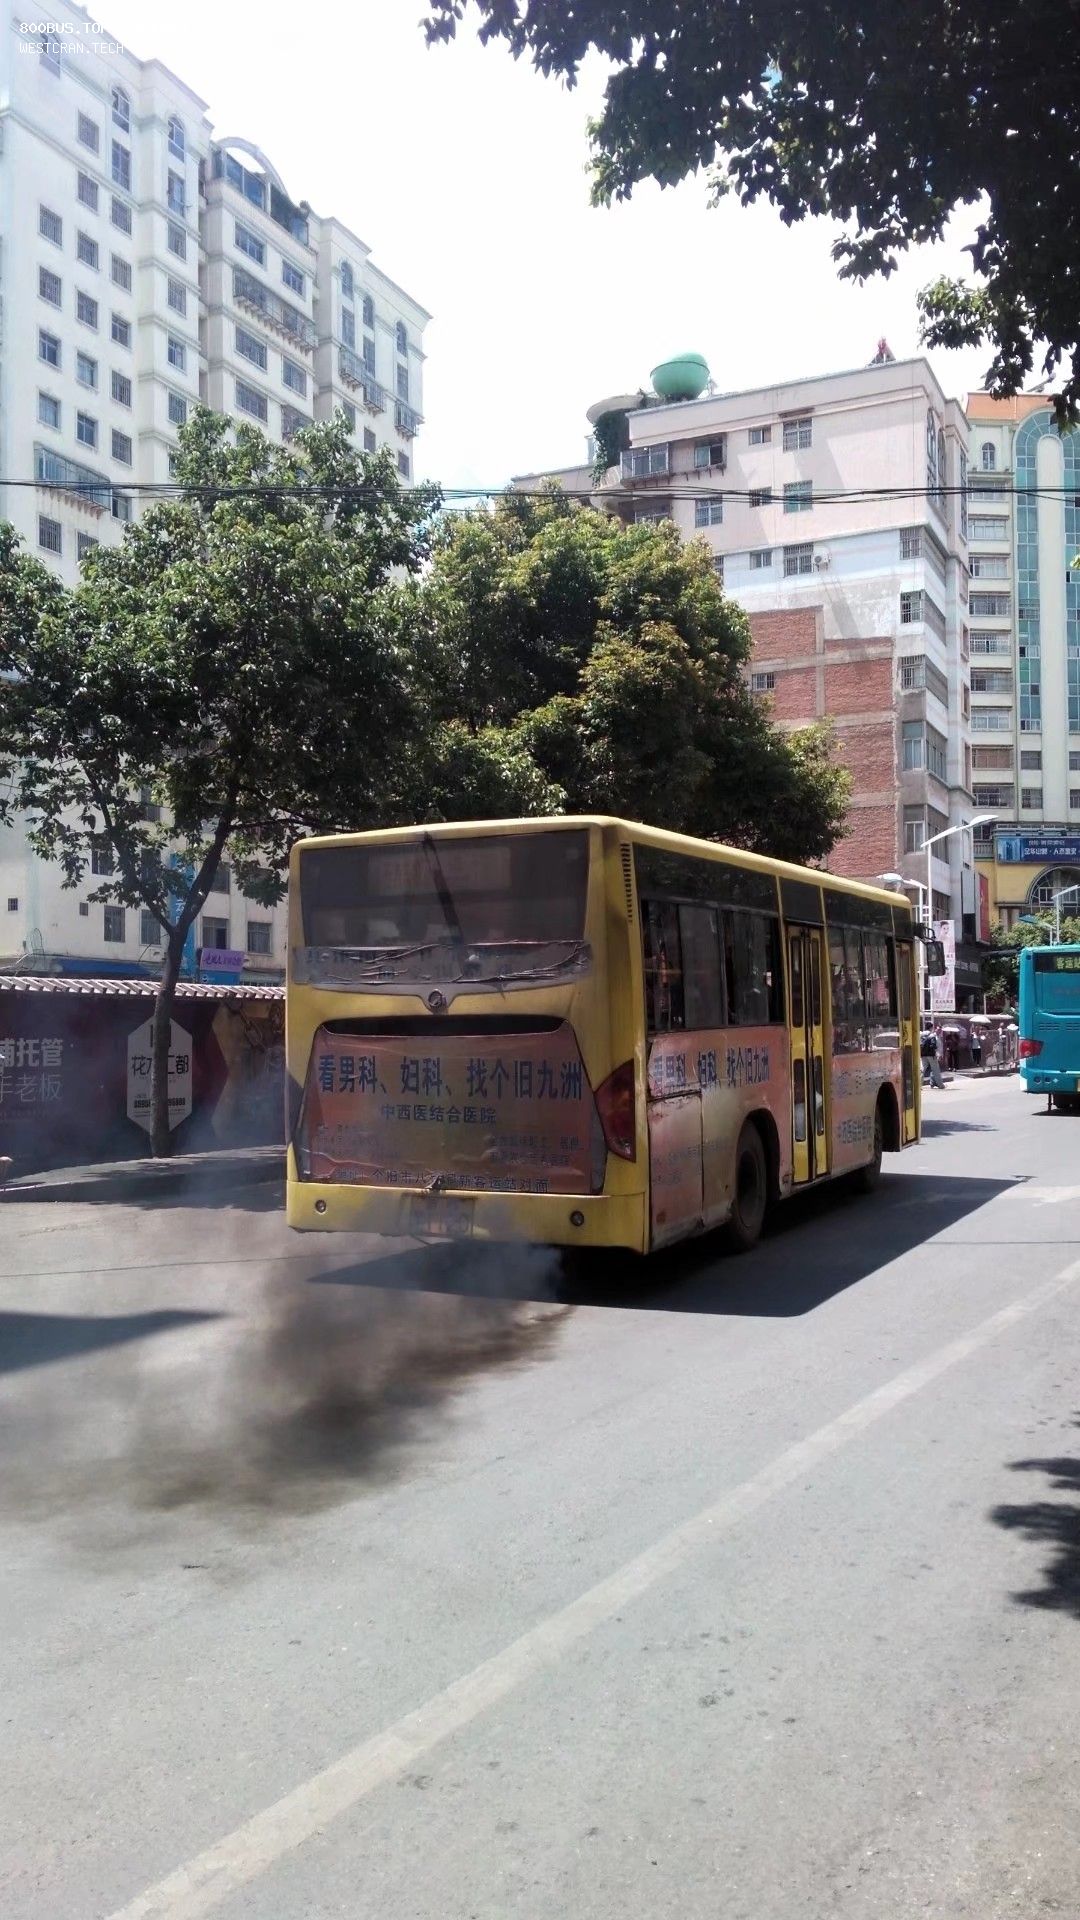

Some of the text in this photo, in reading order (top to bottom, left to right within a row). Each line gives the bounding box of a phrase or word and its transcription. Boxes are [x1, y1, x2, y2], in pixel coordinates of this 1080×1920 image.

[381, 1103, 497, 1125] 中西医结合医院
